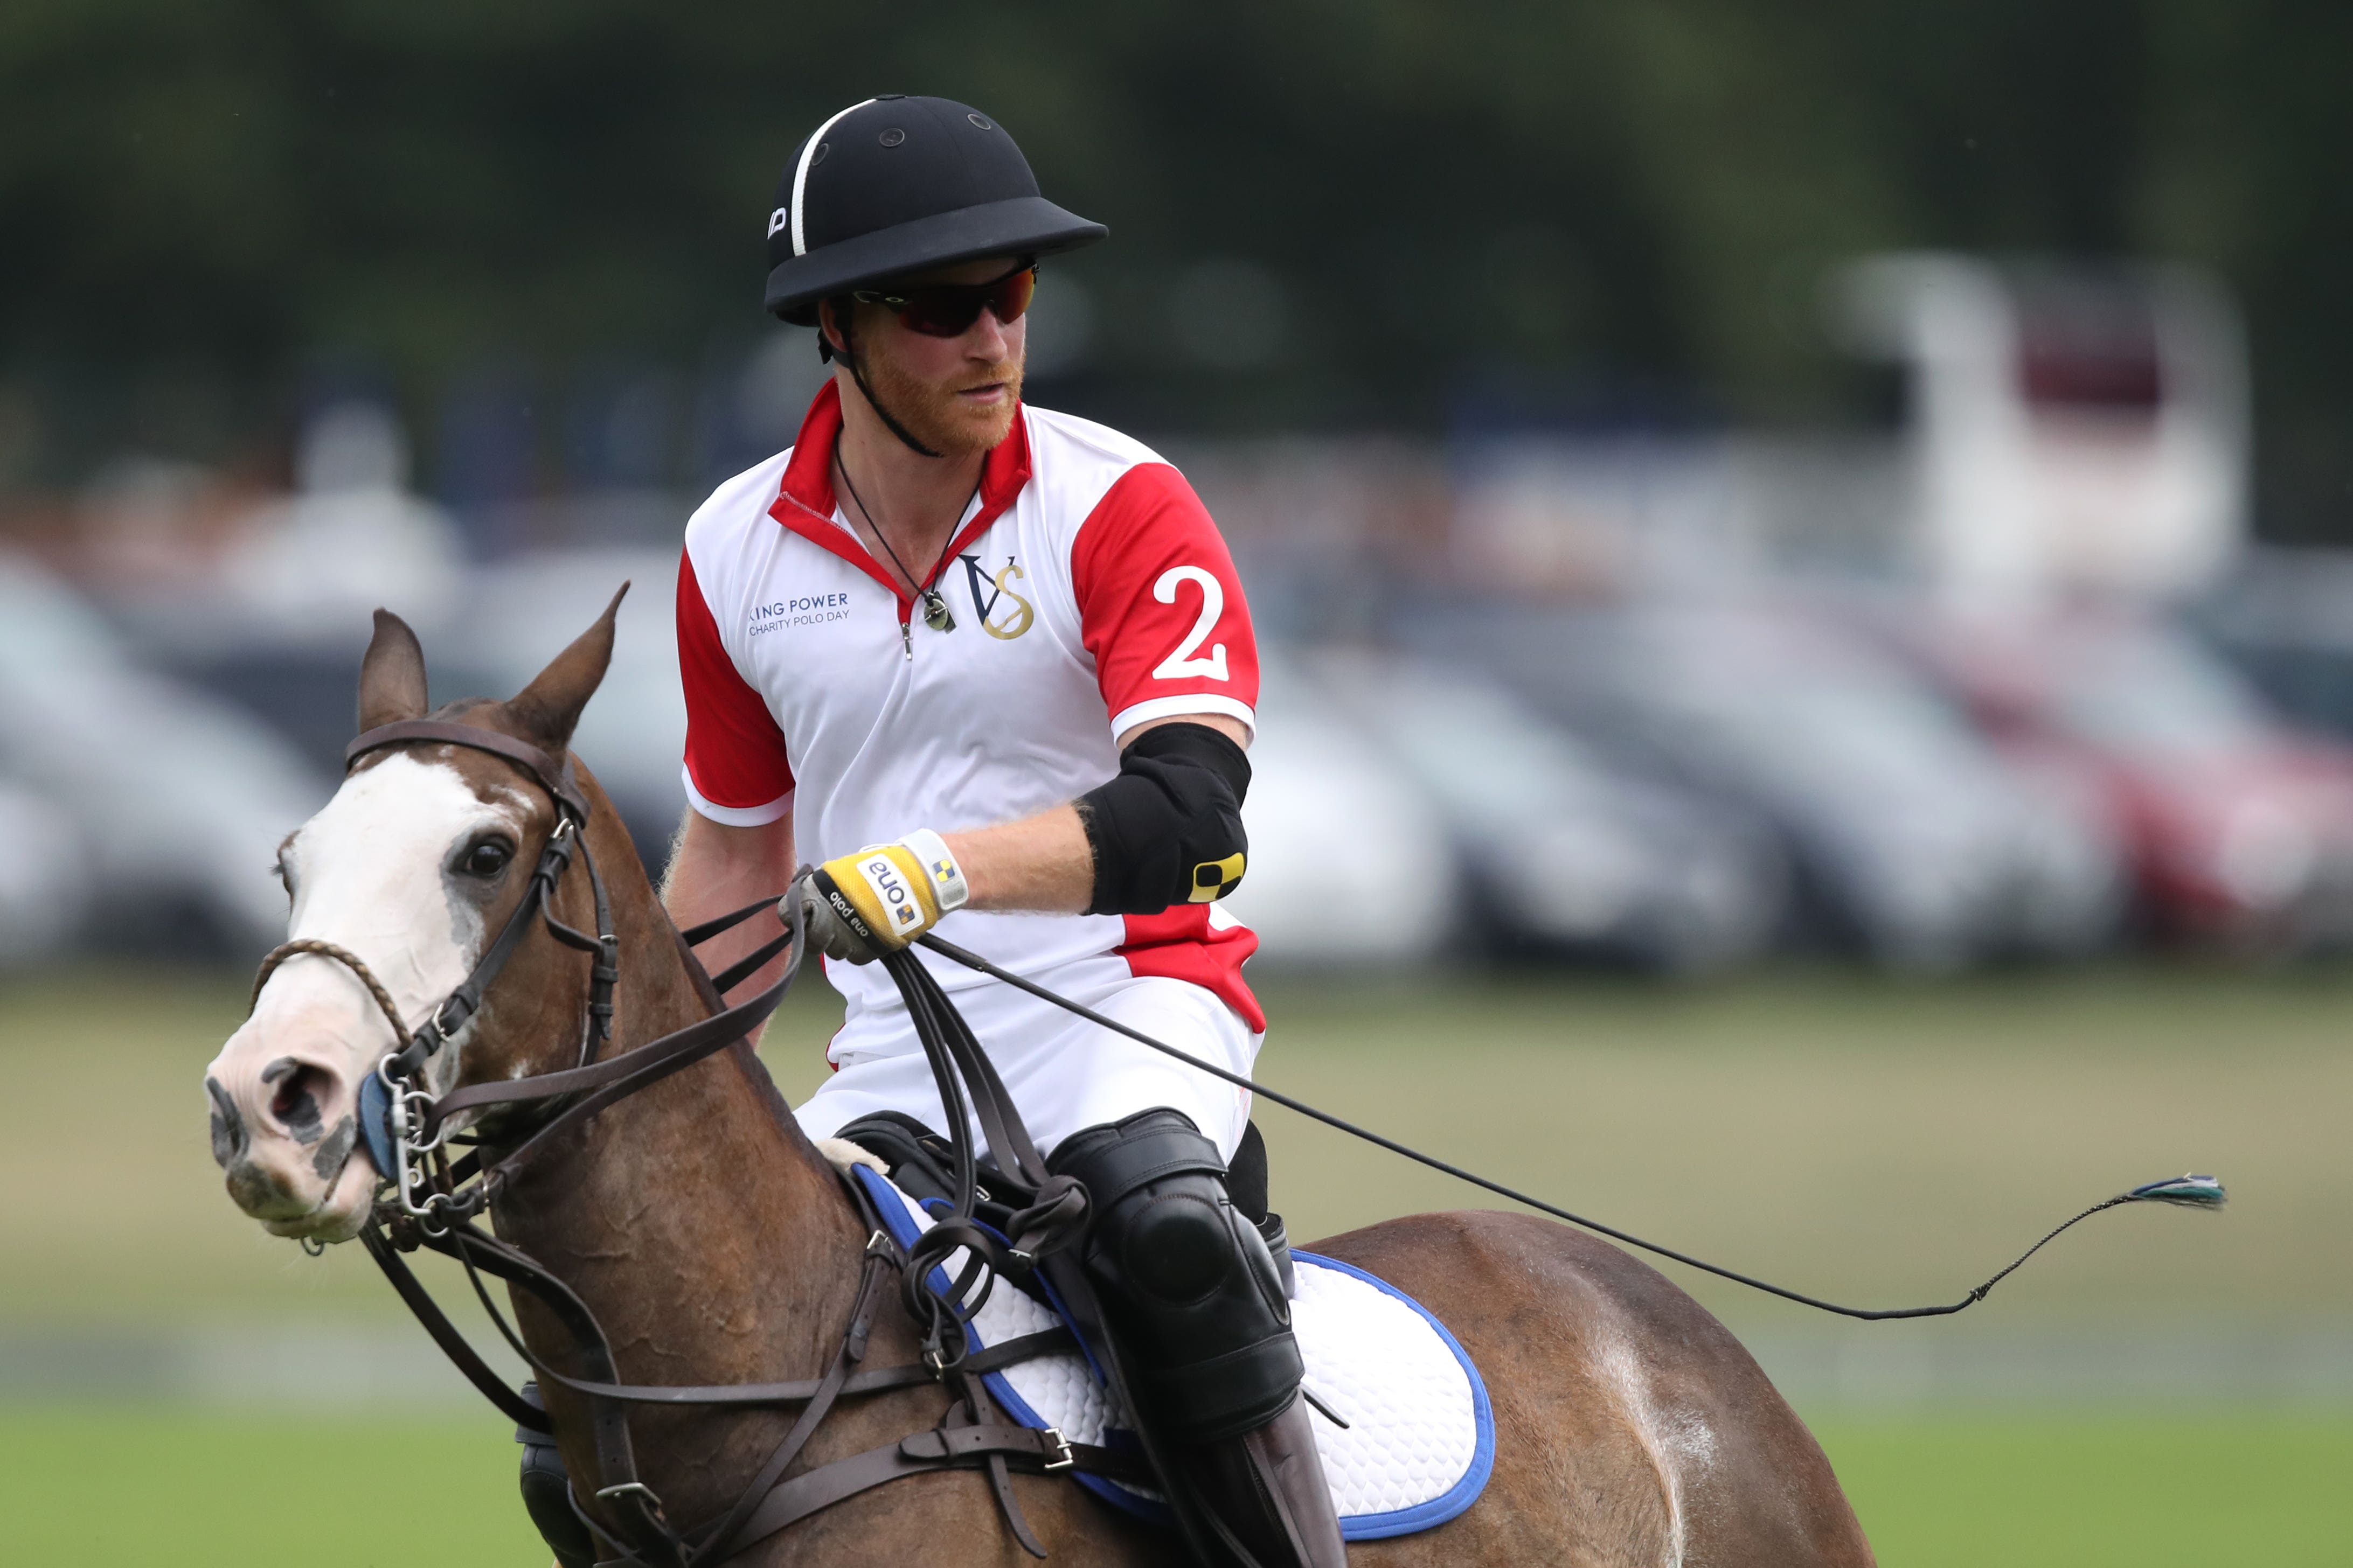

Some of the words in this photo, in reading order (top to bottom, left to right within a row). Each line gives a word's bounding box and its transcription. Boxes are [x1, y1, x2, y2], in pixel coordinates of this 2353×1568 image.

[789, 593, 848, 612] POWER
[749, 618, 791, 636] CHARITY
[793, 614, 824, 626] POLO
[827, 609, 850, 622] DAY
[1152, 565, 1230, 682] 2
[869, 862, 905, 904] ona
[830, 891, 854, 918] polo
[850, 917, 869, 937] ona
